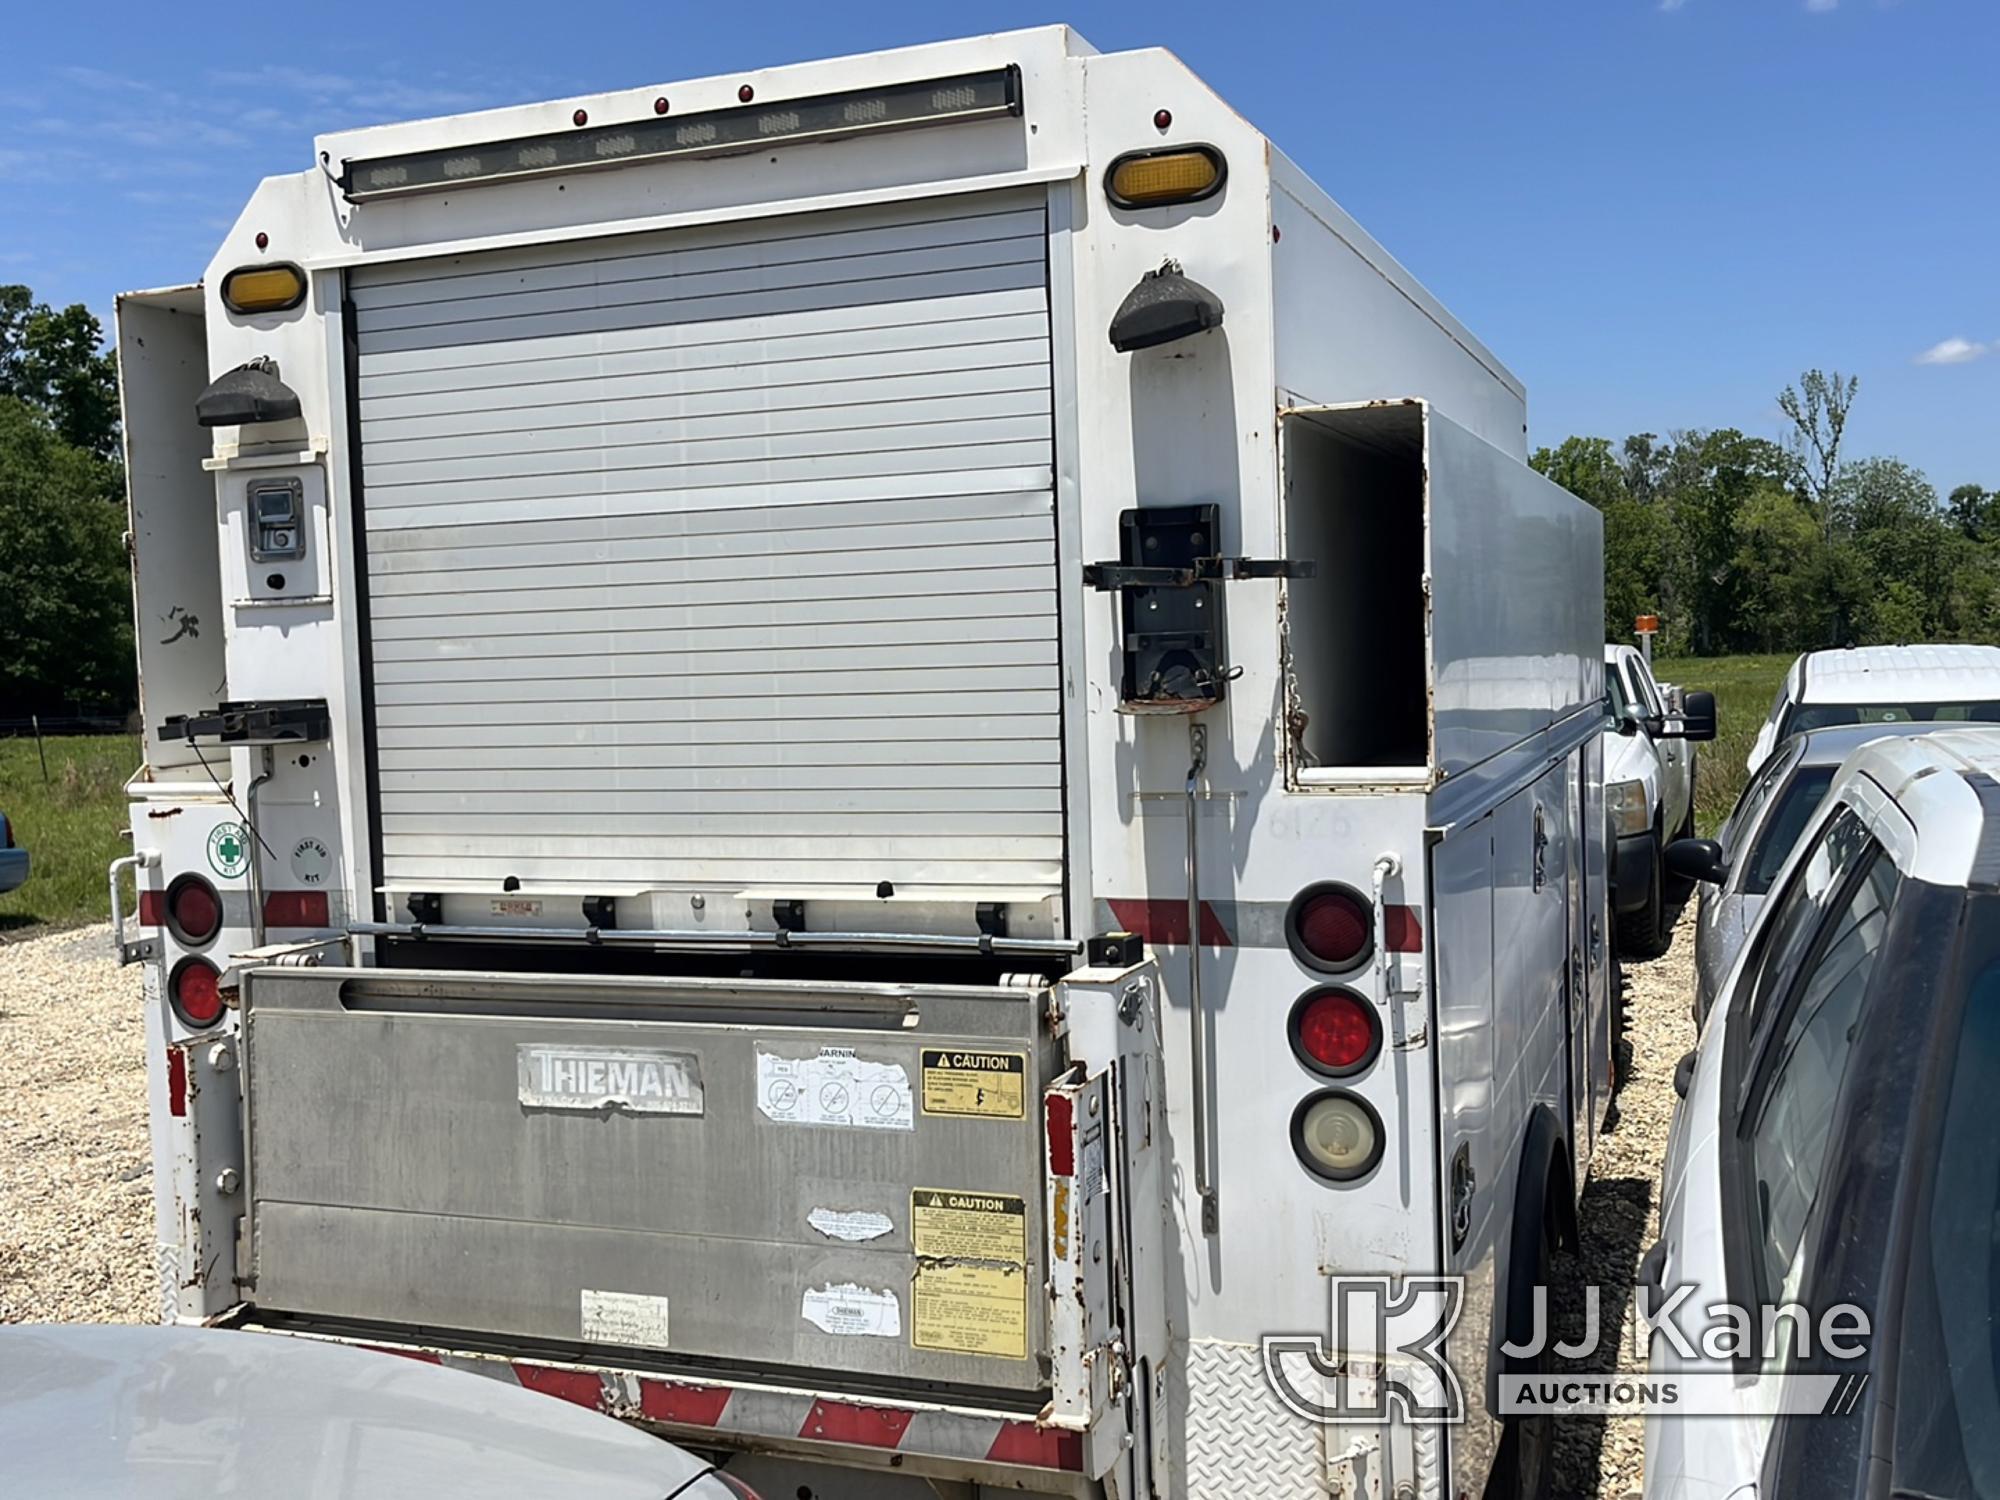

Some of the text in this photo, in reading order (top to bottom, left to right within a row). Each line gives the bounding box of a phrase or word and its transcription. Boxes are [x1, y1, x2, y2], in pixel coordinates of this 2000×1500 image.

[212, 826, 248, 845] FIRST AID
[294, 840, 327, 858] FIRST AID
[304, 873, 320, 882] KIT
[953, 1054, 1010, 1070] CAUTION
[530, 1050, 690, 1098] THIEMAN
[949, 1196, 1004, 1211] CAUTION
